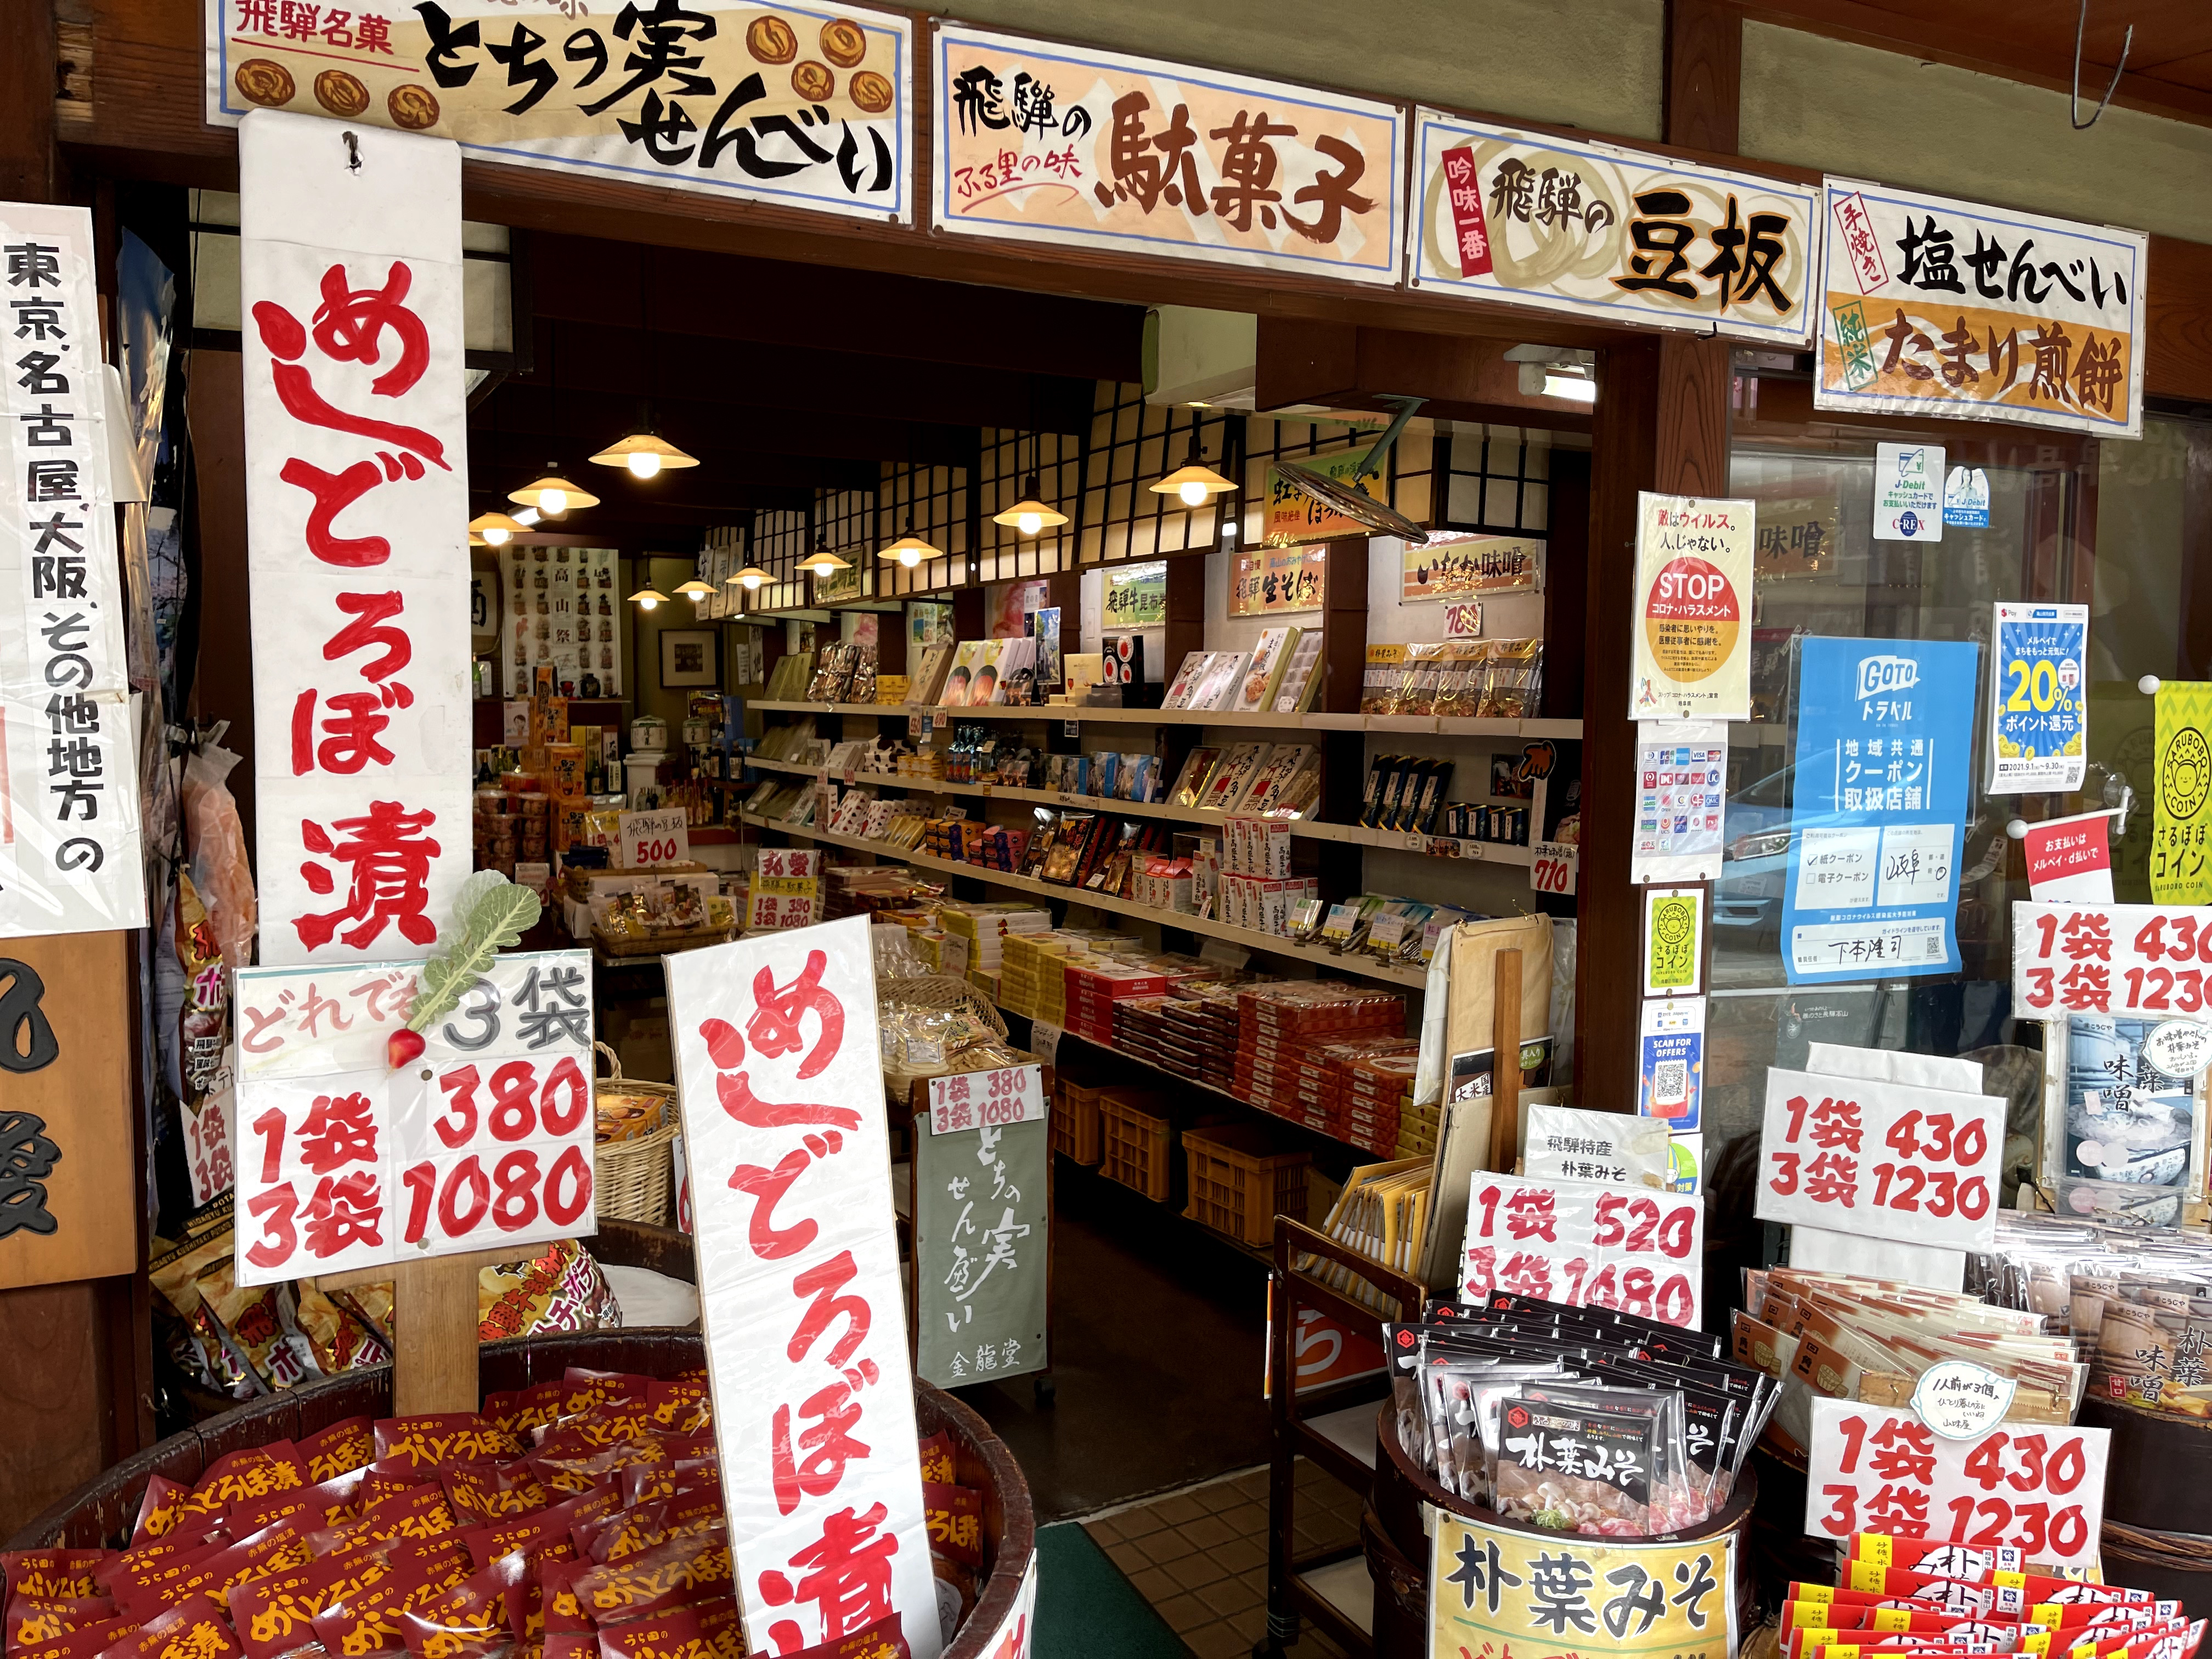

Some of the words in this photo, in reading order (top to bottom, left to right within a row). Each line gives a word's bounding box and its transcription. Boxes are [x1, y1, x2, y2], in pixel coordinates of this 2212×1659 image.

[416, 1, 718, 115] とちの実
[617, 73, 894, 194] せんべい
[955, 144, 1084, 195] ふる里の味
[1094, 92, 1380, 244] 駄菓子
[1447, 157, 1488, 261] 吟味一番
[1489, 158, 1615, 234] 飛騨の
[1609, 188, 1795, 315] 豆板
[1843, 203, 1882, 284] 手焼き
[1895, 215, 2128, 311] 塩せんべい
[1839, 311, 1872, 380] 純米
[1882, 307, 2124, 414] たまり煎餅
[1883, 499, 1938, 510] お支払いいただけます
[1888, 490, 1934, 501] キャッシュカードで
[1657, 508, 1735, 531] 敵はウイルス。
[1892, 518, 1925, 532] C-REX
[1660, 532, 1730, 553] 人、じゃない。
[1659, 572, 1725, 600] STOP
[1651, 602, 1731, 618] コロナ・ハラスメント
[1658, 635, 1722, 646] 医療従事者に感謝を。
[1659, 623, 1718, 634] 感染者に思いやりを。
[2027, 636, 2057, 646] メルペイで
[2007, 659, 2073, 713] 20%
[1862, 701, 1912, 721] トラベル
[2006, 714, 2075, 732] ポイント還元
[1845, 738, 1924, 758] 地域共通
[2167, 733, 2208, 769] SARUBOBO
[1708, 773, 1719, 783] UC
[1845, 760, 1923, 783] クーポン
[1844, 786, 1922, 812] 取扱店舗
[2170, 795, 2197, 813] COIN
[2045, 832, 2086, 853] お支払いは
[2158, 823, 2208, 848] さるぼぼ
[636, 838, 677, 864] 500
[1819, 854, 1863, 865] 紙クーポン
[2156, 848, 2205, 878] コイン
[1534, 859, 1568, 892] 710
[1818, 872, 1869, 884] 電子クーポン
[2186, 881, 2203, 889] COIN
[788, 898, 811, 913] 380
[1660, 906, 1688, 922] SARUBOBO
[780, 914, 808, 928] 1080
[1656, 943, 1690, 956] さるぼぼ
[1664, 933, 1681, 941] COIN
[2036, 912, 2113, 962] 1袋
[1656, 955, 1688, 969] コイン
[2025, 963, 2112, 1013] 3袋
[2124, 967, 2212, 1013] 123
[1653, 1039, 1674, 1049] SCAN
[1676, 1038, 1692, 1047] FOR
[1656, 1047, 1687, 1058] OFFERS
[937, 1076, 970, 1105] 1袋
[988, 1068, 1026, 1098] 380
[2103, 1054, 2136, 1113] 味噌
[252, 1091, 379, 1183] 1袋
[433, 1056, 589, 1149] 380
[936, 1102, 973, 1133] 3袋
[977, 1097, 1025, 1125] 1080
[1786, 1096, 1864, 1153] 1袋
[1886, 1109, 1987, 1167] 430
[1547, 1135, 1612, 1157] 飛騨特産
[1561, 1160, 1627, 1182] 朴葉みそ
[1677, 1182, 1693, 1193] 対策
[1769, 1152, 1859, 1209] 3袋
[1872, 1163, 1990, 1221] 1230
[245, 1170, 383, 1268] 3袋
[403, 1144, 593, 1244] 1080
[1479, 1185, 1558, 1243] 1袋
[1592, 1191, 1696, 1259] 520
[1466, 1245, 1553, 1301] 3袋
[949, 1338, 1022, 1379] 金龍堂
[2172, 1325, 2212, 1387] 朴葉
[2111, 1377, 2124, 1396] 甘口
[2130, 1345, 2169, 1403] 味噌
[1505, 1432, 1645, 1486] 朴葉みそ
[1838, 1415, 1938, 1486] 1袋
[1964, 1431, 2086, 1496] 430
[1820, 1483, 1931, 1539] 3袋
[1948, 1495, 2089, 1557] 1230
[1446, 1533, 1718, 1639] 朴葉みそ
